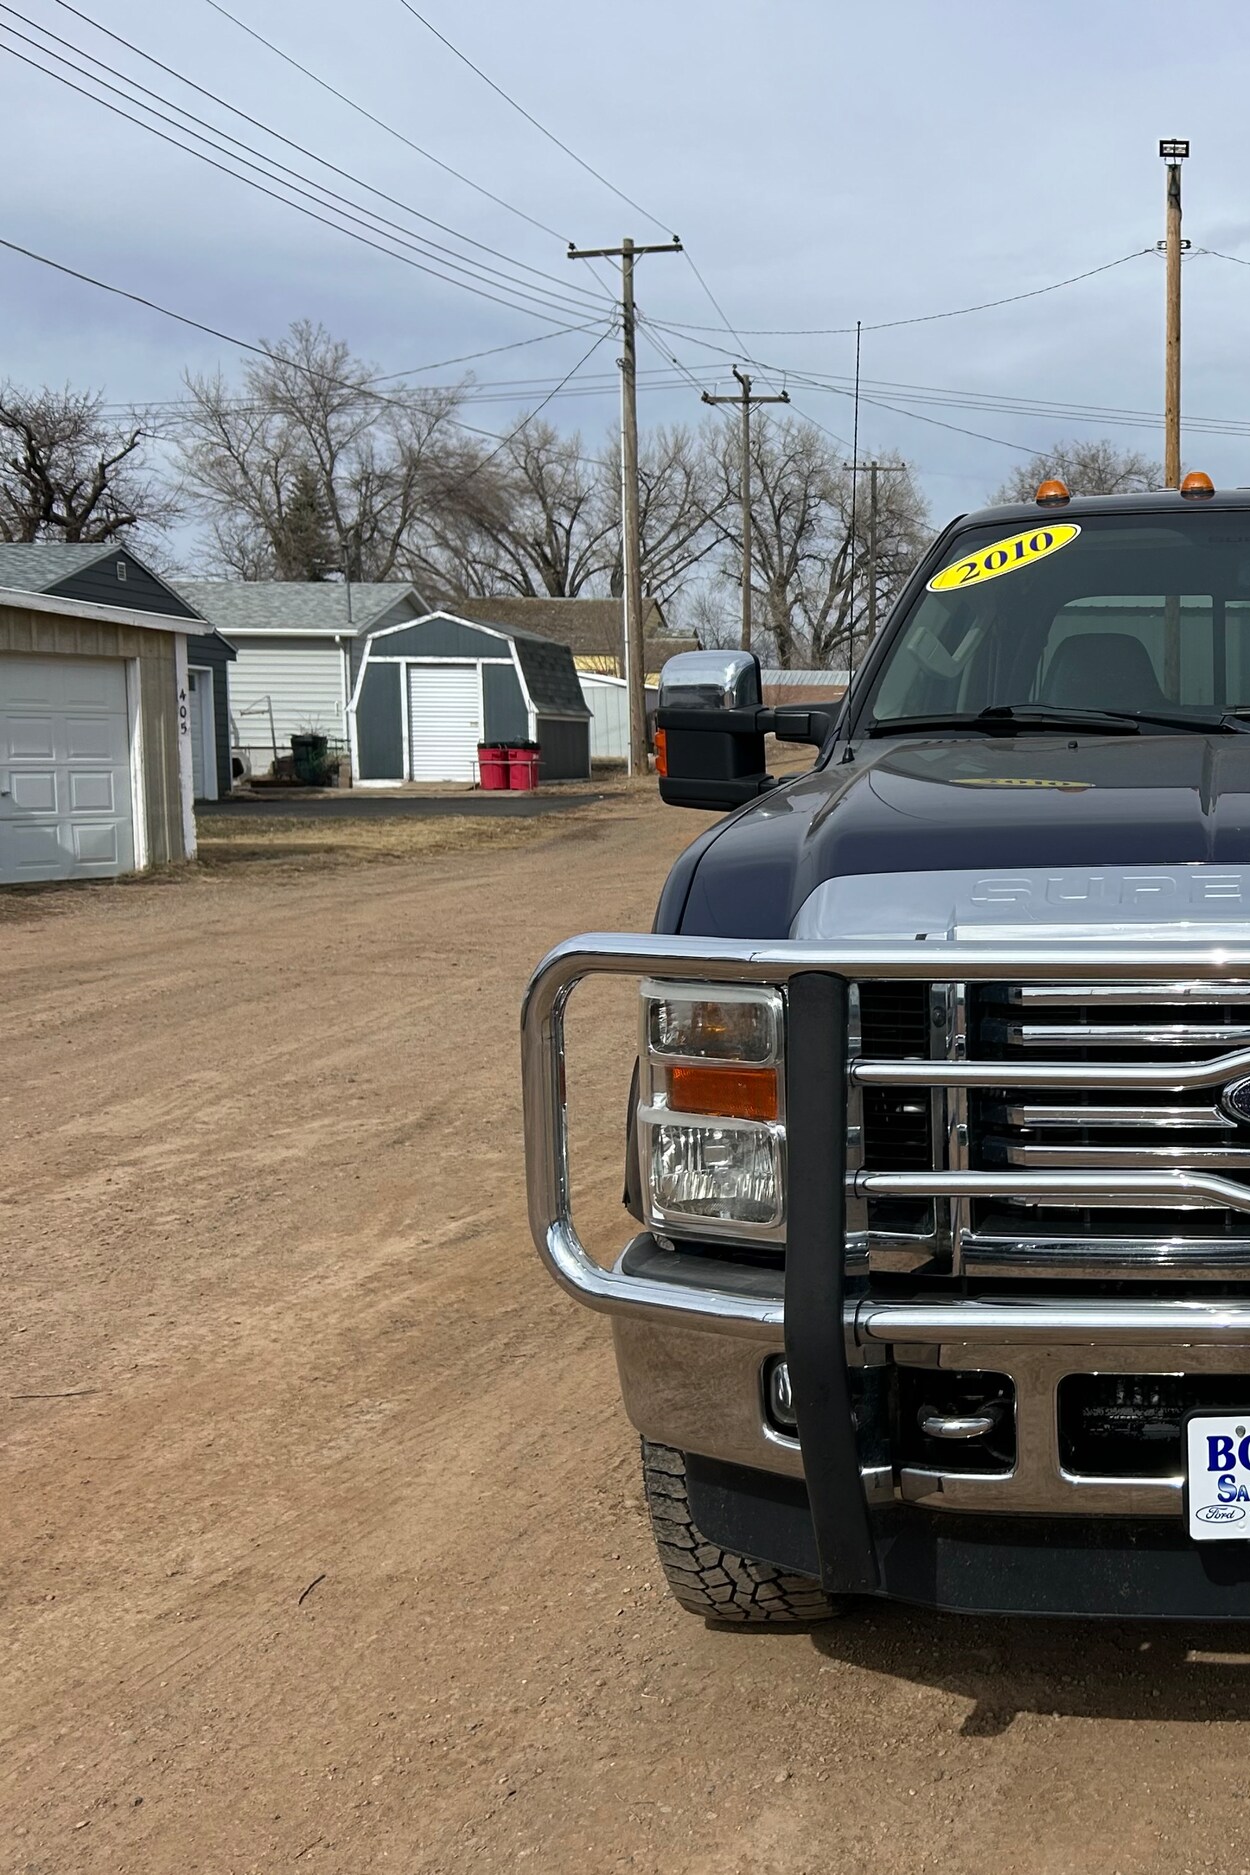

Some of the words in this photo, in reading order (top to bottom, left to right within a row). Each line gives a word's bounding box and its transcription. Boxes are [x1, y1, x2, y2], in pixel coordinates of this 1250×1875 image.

[956, 532, 1054, 584] 2010
[179, 688, 187, 735] 405
[1205, 1505, 1236, 1520] Ford
